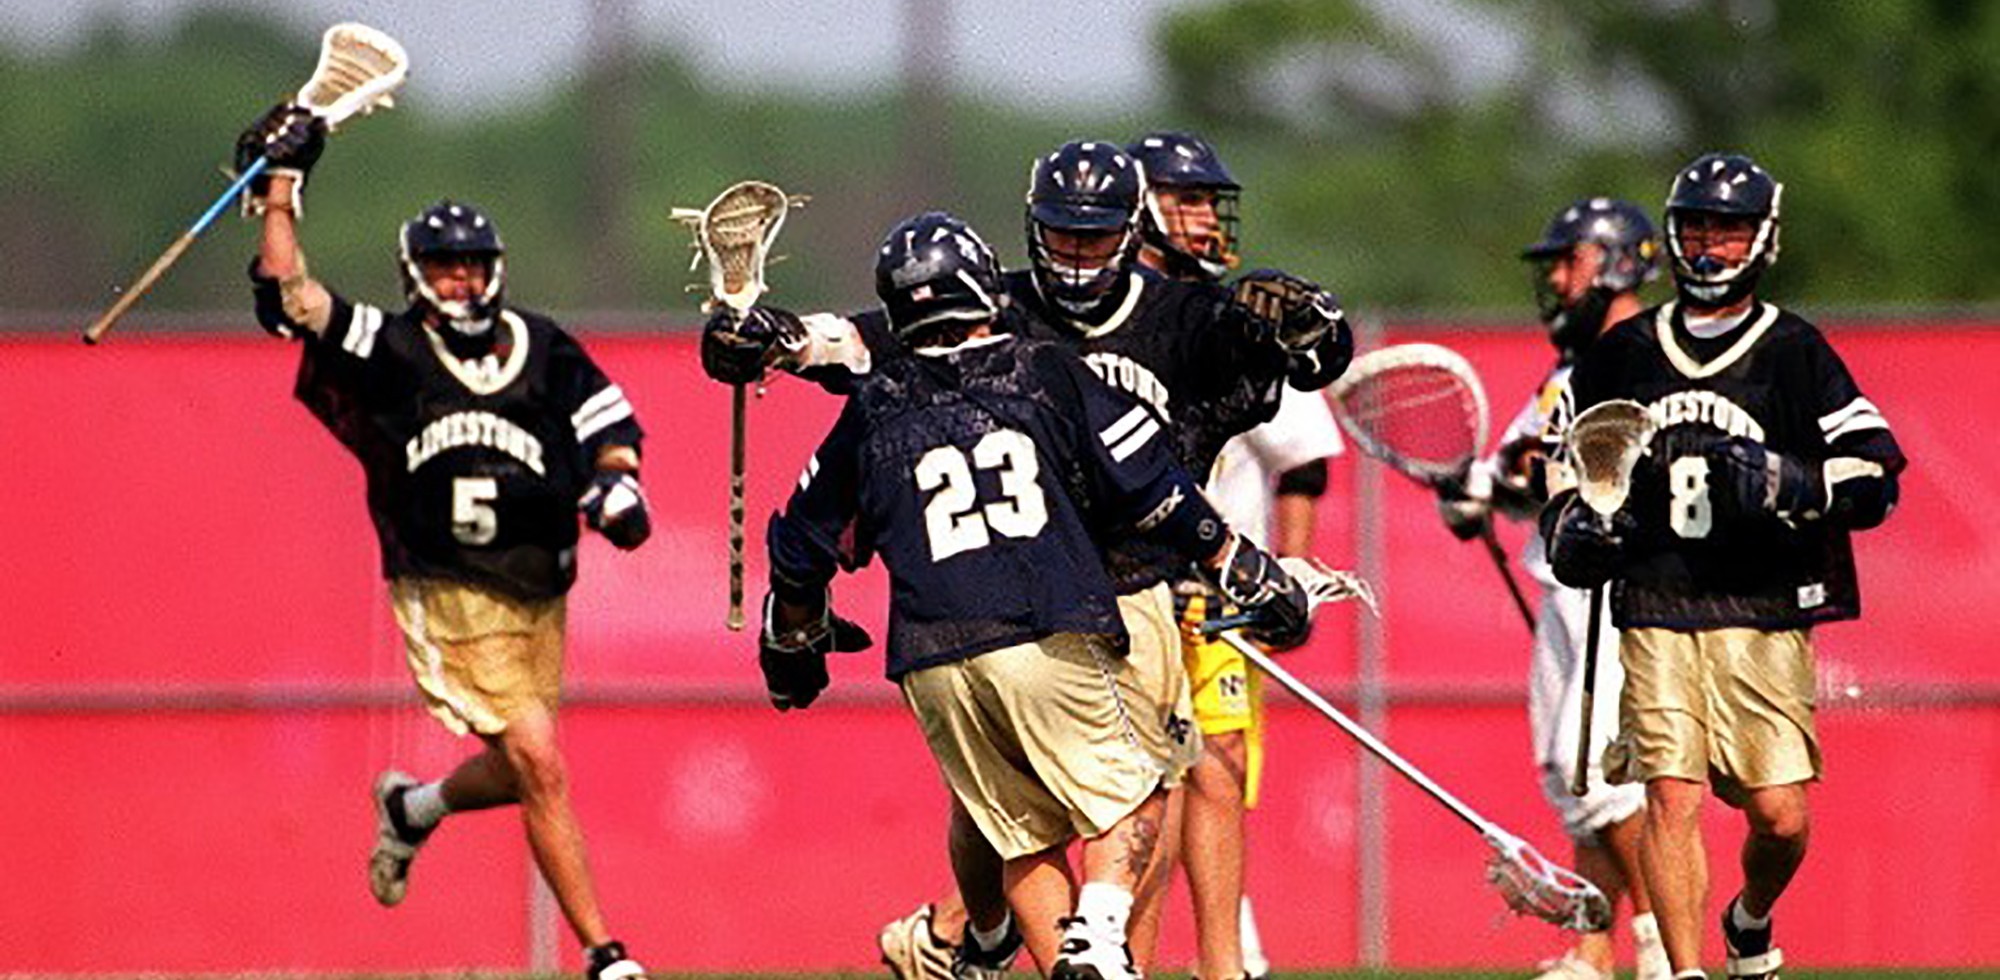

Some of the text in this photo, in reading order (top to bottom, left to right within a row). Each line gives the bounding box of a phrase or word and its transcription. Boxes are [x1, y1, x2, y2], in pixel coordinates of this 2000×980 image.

[406, 411, 546, 476] LIMESTONE
[453, 477, 498, 545] 5
[914, 428, 1048, 562] 23
[1669, 456, 1713, 539] 8
